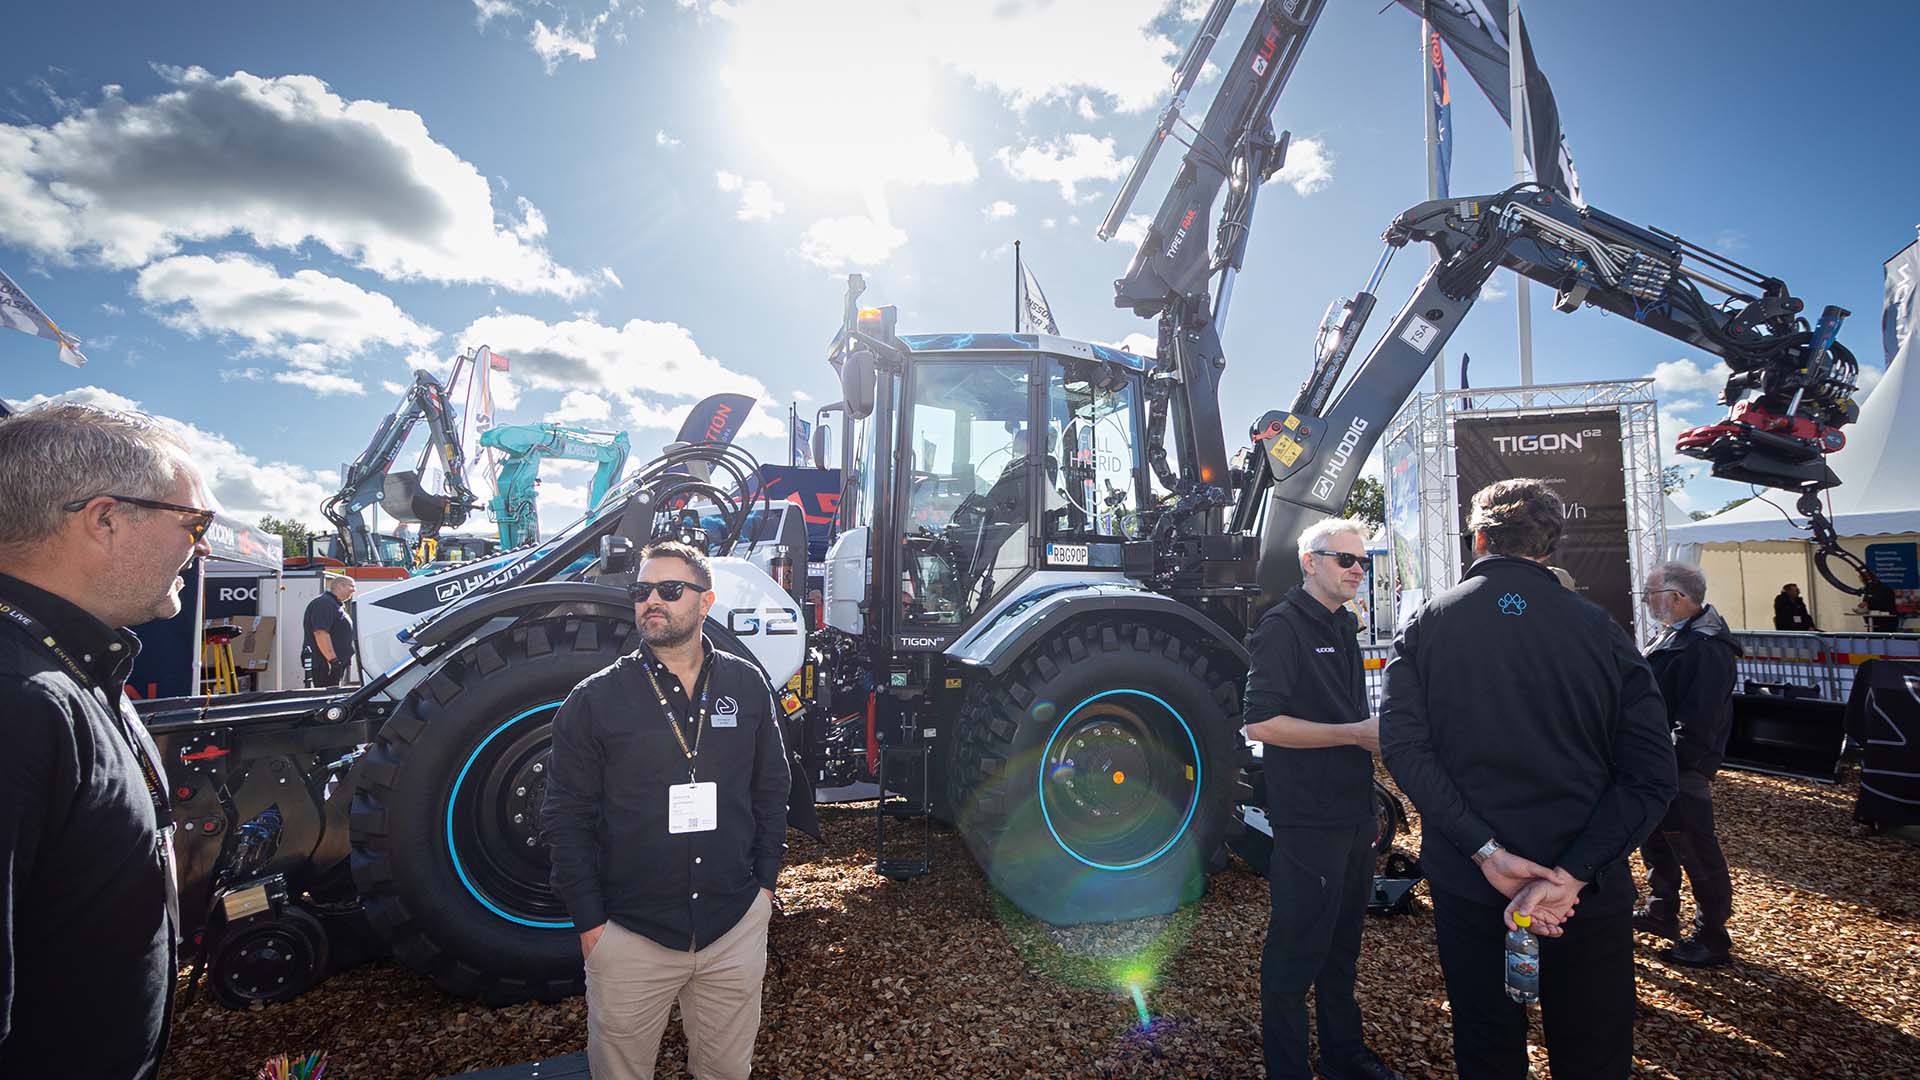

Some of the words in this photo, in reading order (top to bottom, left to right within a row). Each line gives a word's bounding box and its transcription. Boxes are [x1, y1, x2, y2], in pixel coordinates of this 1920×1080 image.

[1166, 235, 1183, 258] TYPE
[1410, 324, 1430, 344] TSA
[1325, 416, 1369, 478] HUDDIG
[1053, 547, 1087, 562] RBG90P
[9, 610, 33, 626] LIVE
[728, 607, 798, 636] G2
[900, 637, 937, 647] TIGON
